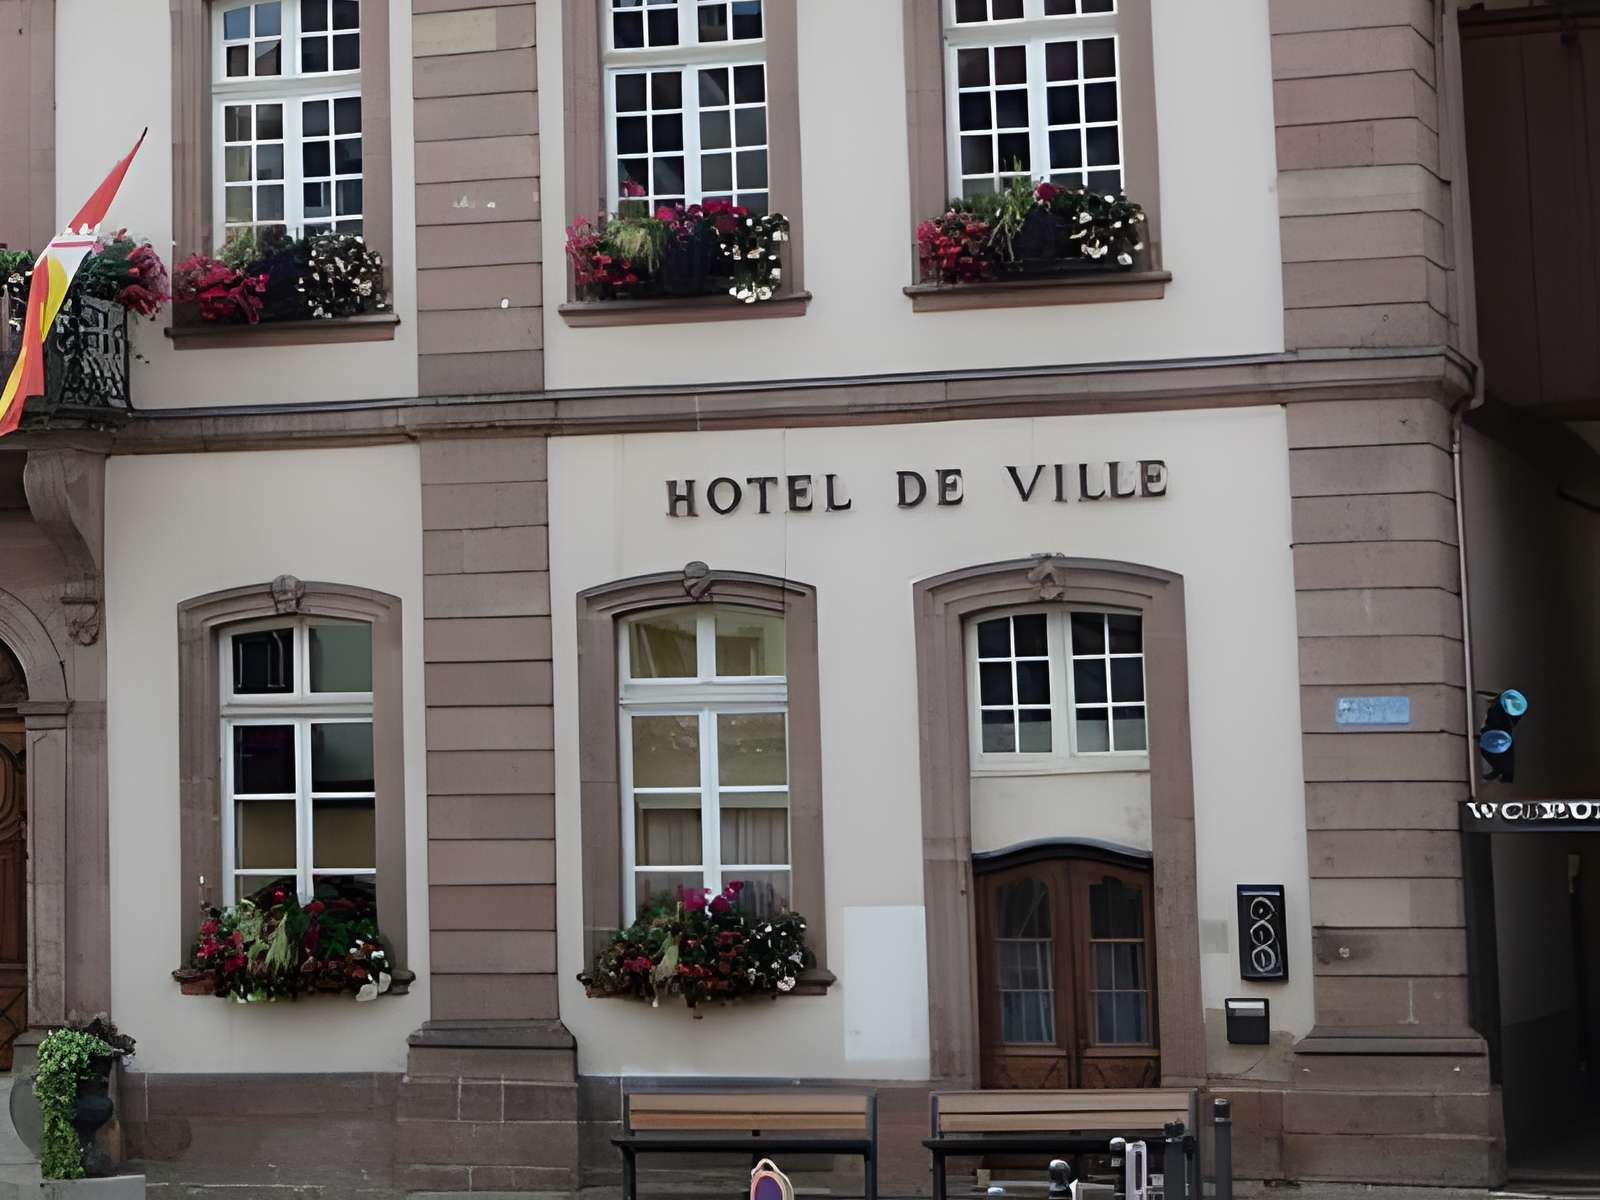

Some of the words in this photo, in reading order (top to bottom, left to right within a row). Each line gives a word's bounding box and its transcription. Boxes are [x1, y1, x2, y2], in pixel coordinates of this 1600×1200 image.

[666, 474, 852, 518] HOTEL
[896, 468, 963, 507] DE
[1004, 460, 1168, 503] VILLE
